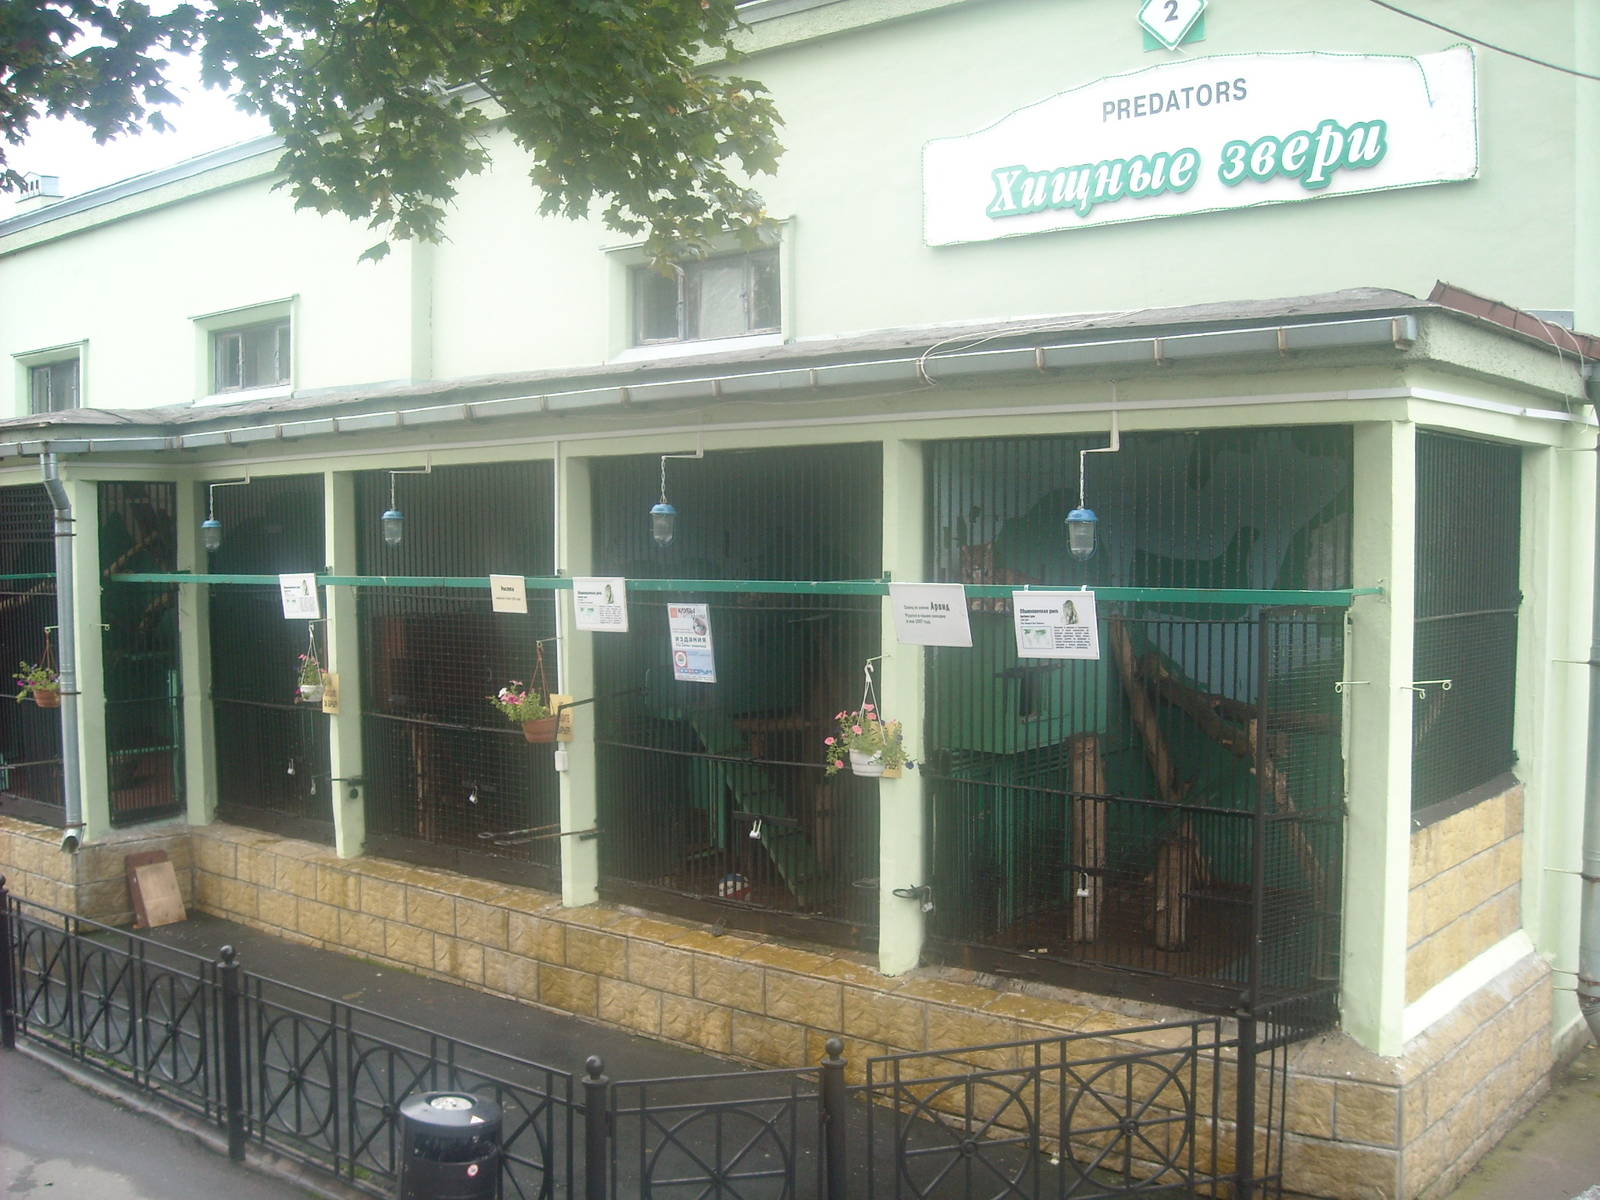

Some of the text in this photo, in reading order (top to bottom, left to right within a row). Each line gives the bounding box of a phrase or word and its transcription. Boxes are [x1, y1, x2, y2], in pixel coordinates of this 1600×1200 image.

[1163, 0, 1178, 22] 2
[1102, 78, 1248, 122] PREDATORS
[988, 120, 1386, 216] Хищные звери
